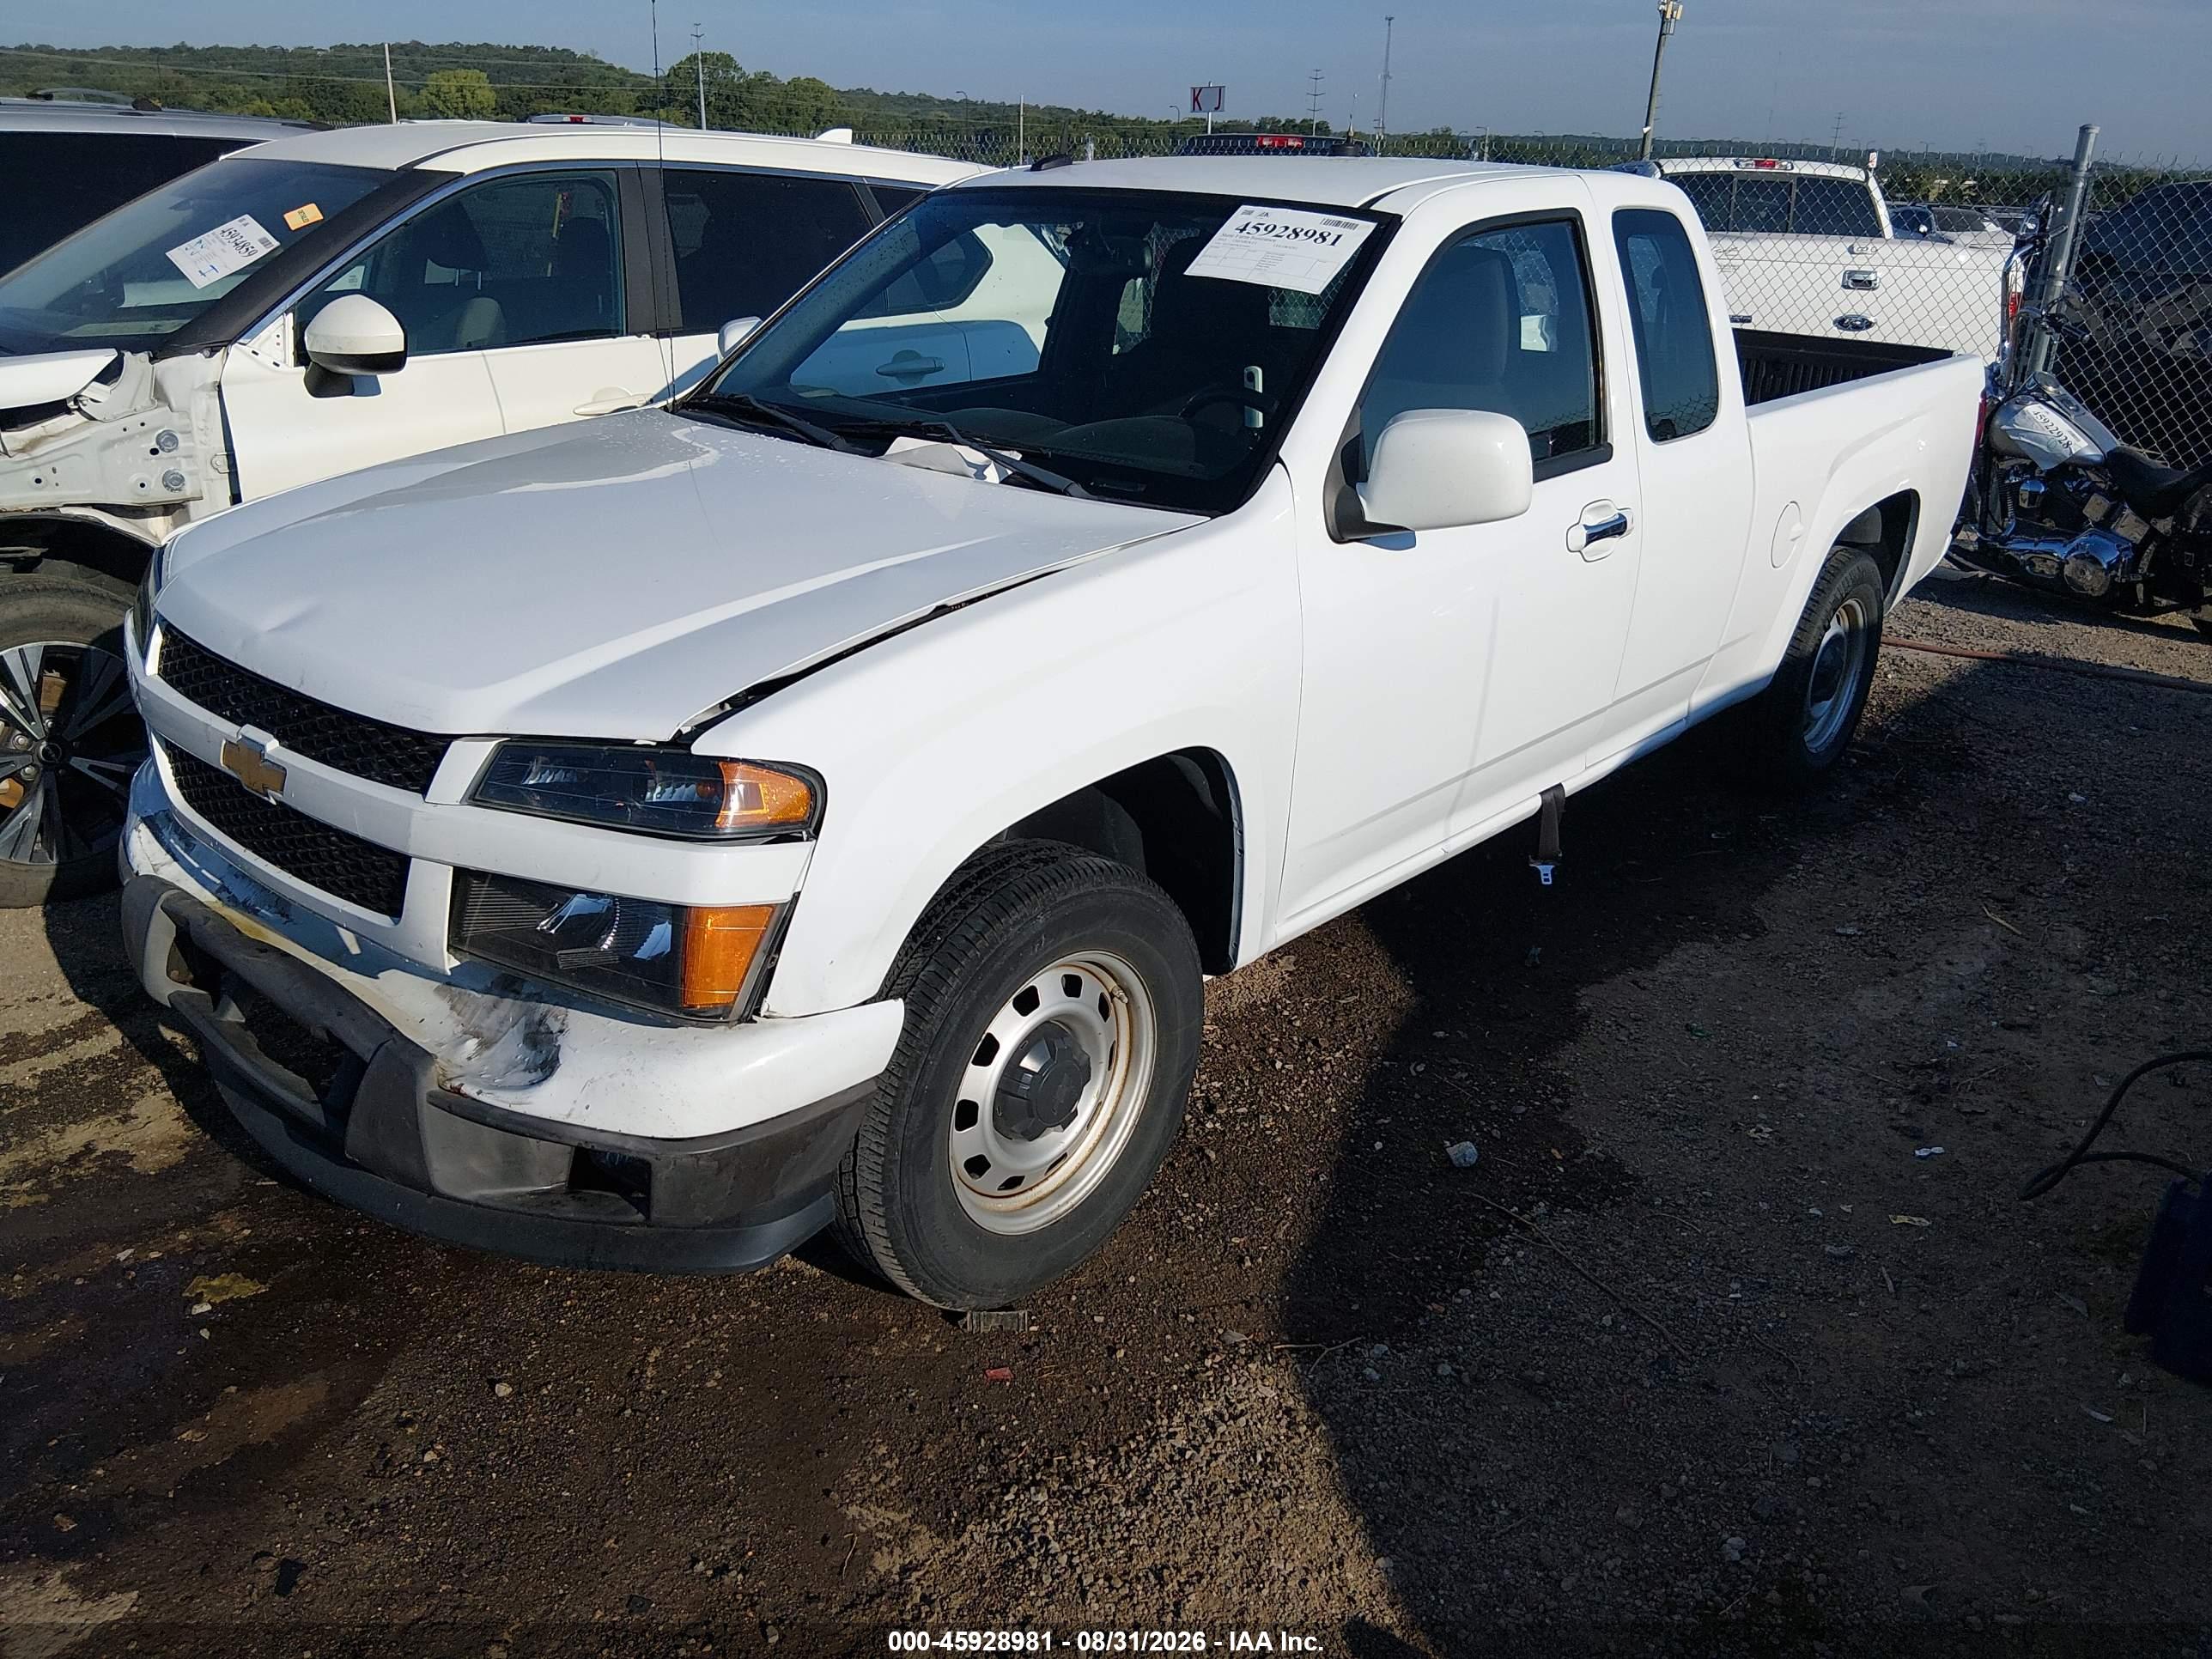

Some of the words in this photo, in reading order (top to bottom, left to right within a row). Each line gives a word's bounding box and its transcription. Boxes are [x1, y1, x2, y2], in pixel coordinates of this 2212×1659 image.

[1192, 88, 1202, 111] K
[1214, 88, 1222, 111] J
[218, 227, 258, 258] 45934859
[1234, 221, 1344, 247] 45928981
[2032, 410, 2074, 452] 45922928
